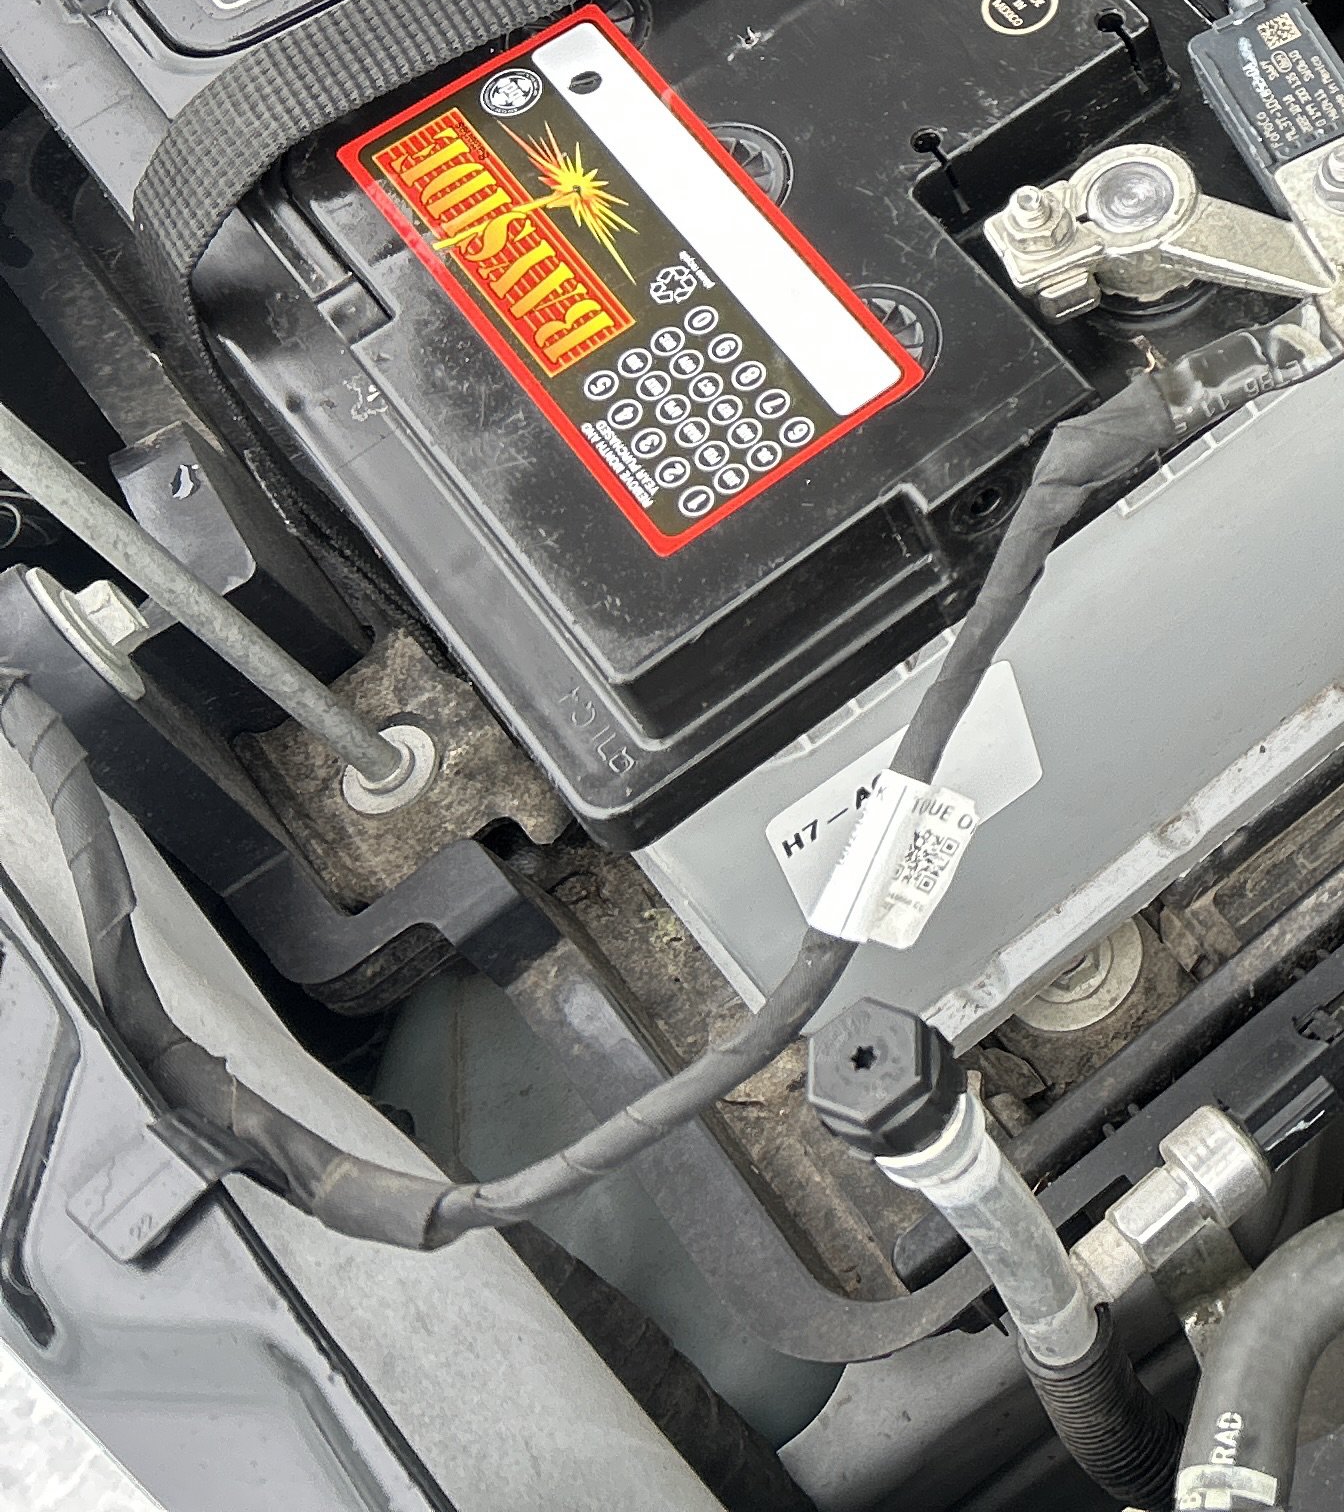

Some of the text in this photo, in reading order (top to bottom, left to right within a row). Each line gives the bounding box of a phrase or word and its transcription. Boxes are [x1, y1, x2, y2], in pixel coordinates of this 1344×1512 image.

[992, 0, 1024, 27] MEXICO
[1013, 0, 1027, 11] IN
[389, 121, 615, 365] BAYSIDE
[689, 306, 810, 443] 6 7 8 9 0
[578, 420, 656, 507] REMOVE MONTH AND
[588, 372, 709, 512] 1 2 3 4 5
[593, 418, 661, 495] YEAR PURCHASED
[1211, 1412, 1243, 1465] RAD
